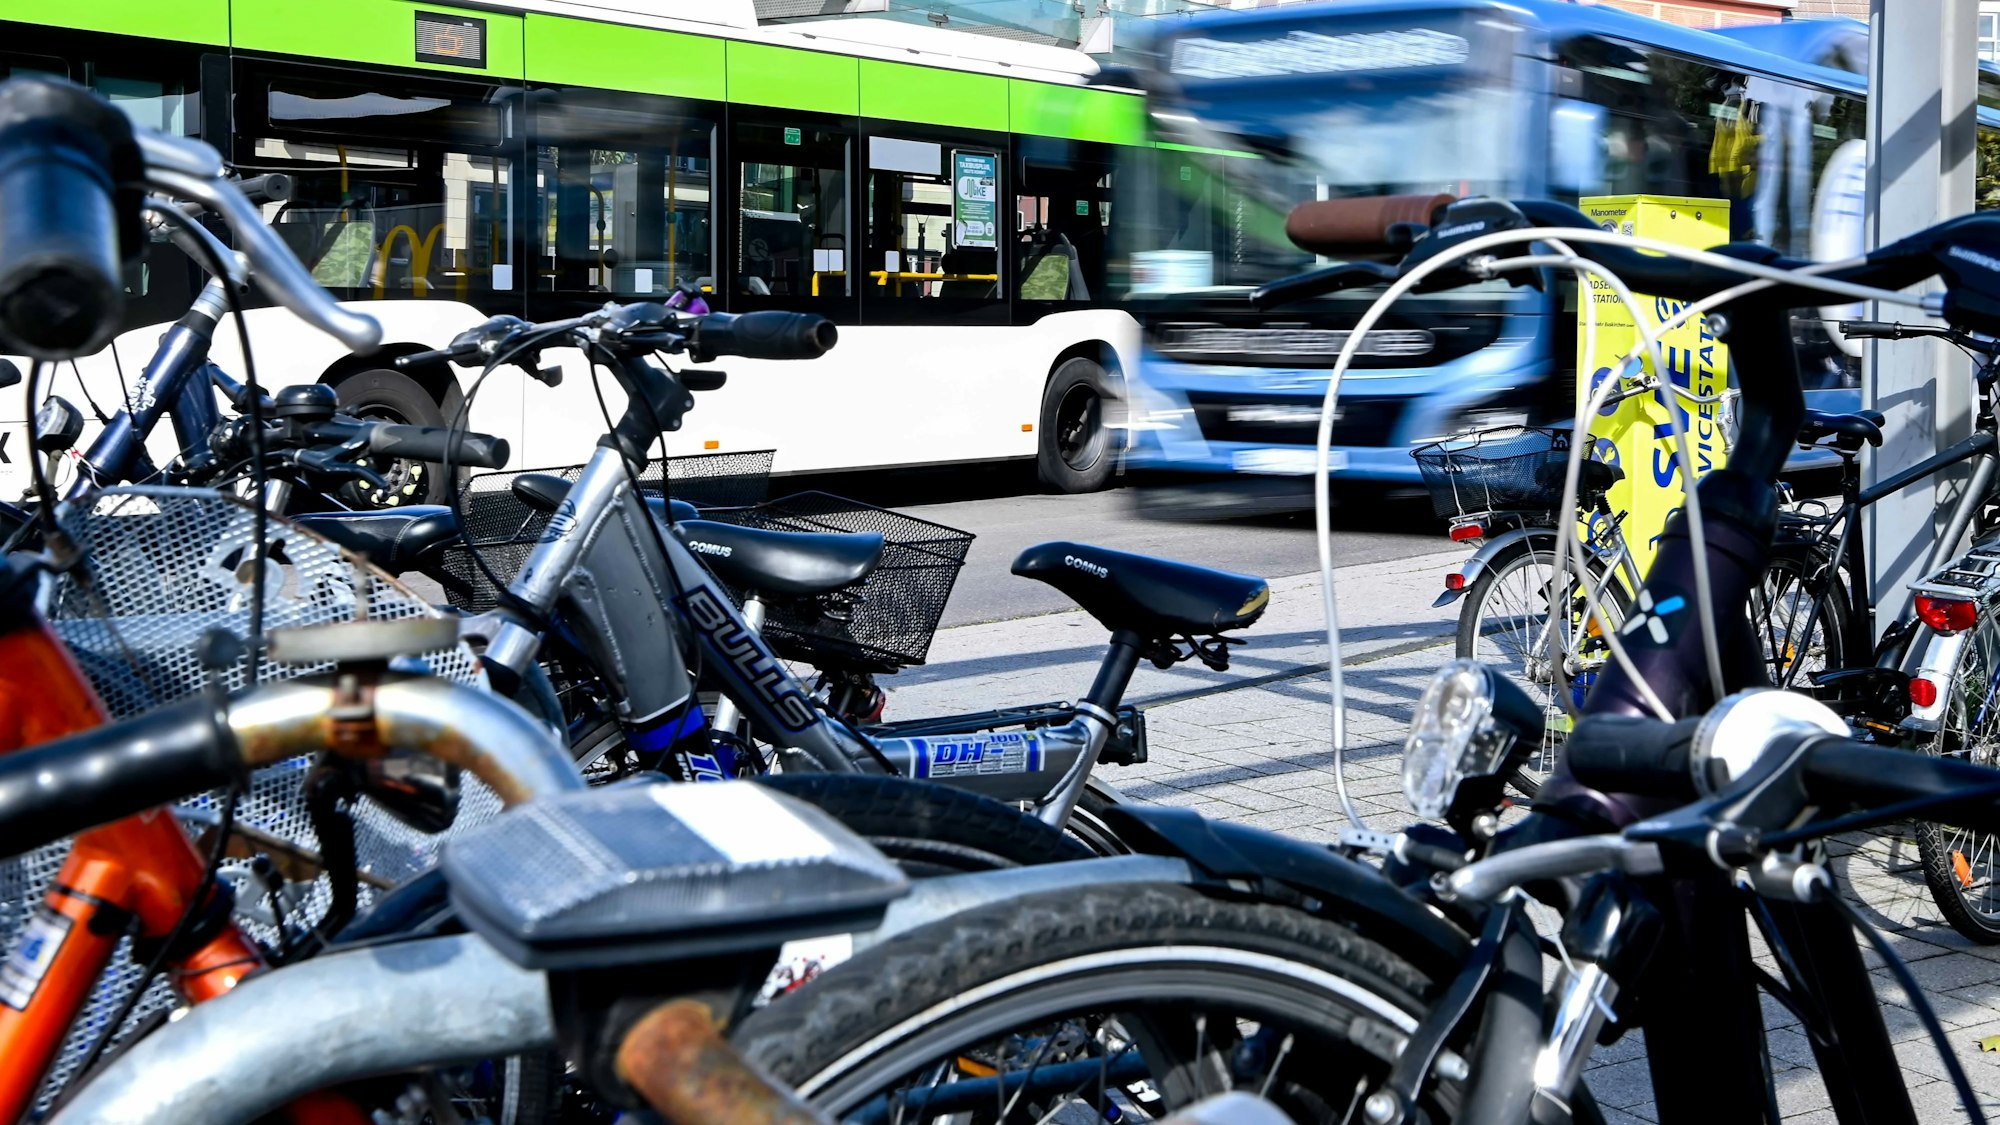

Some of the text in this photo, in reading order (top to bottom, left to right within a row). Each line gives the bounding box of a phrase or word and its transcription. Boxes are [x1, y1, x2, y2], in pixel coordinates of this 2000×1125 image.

[1590, 208, 1628, 217] Manometer
[689, 540, 733, 558] COMUS
[1064, 554, 1109, 579] COMUS
[688, 590, 815, 727] BULLS
